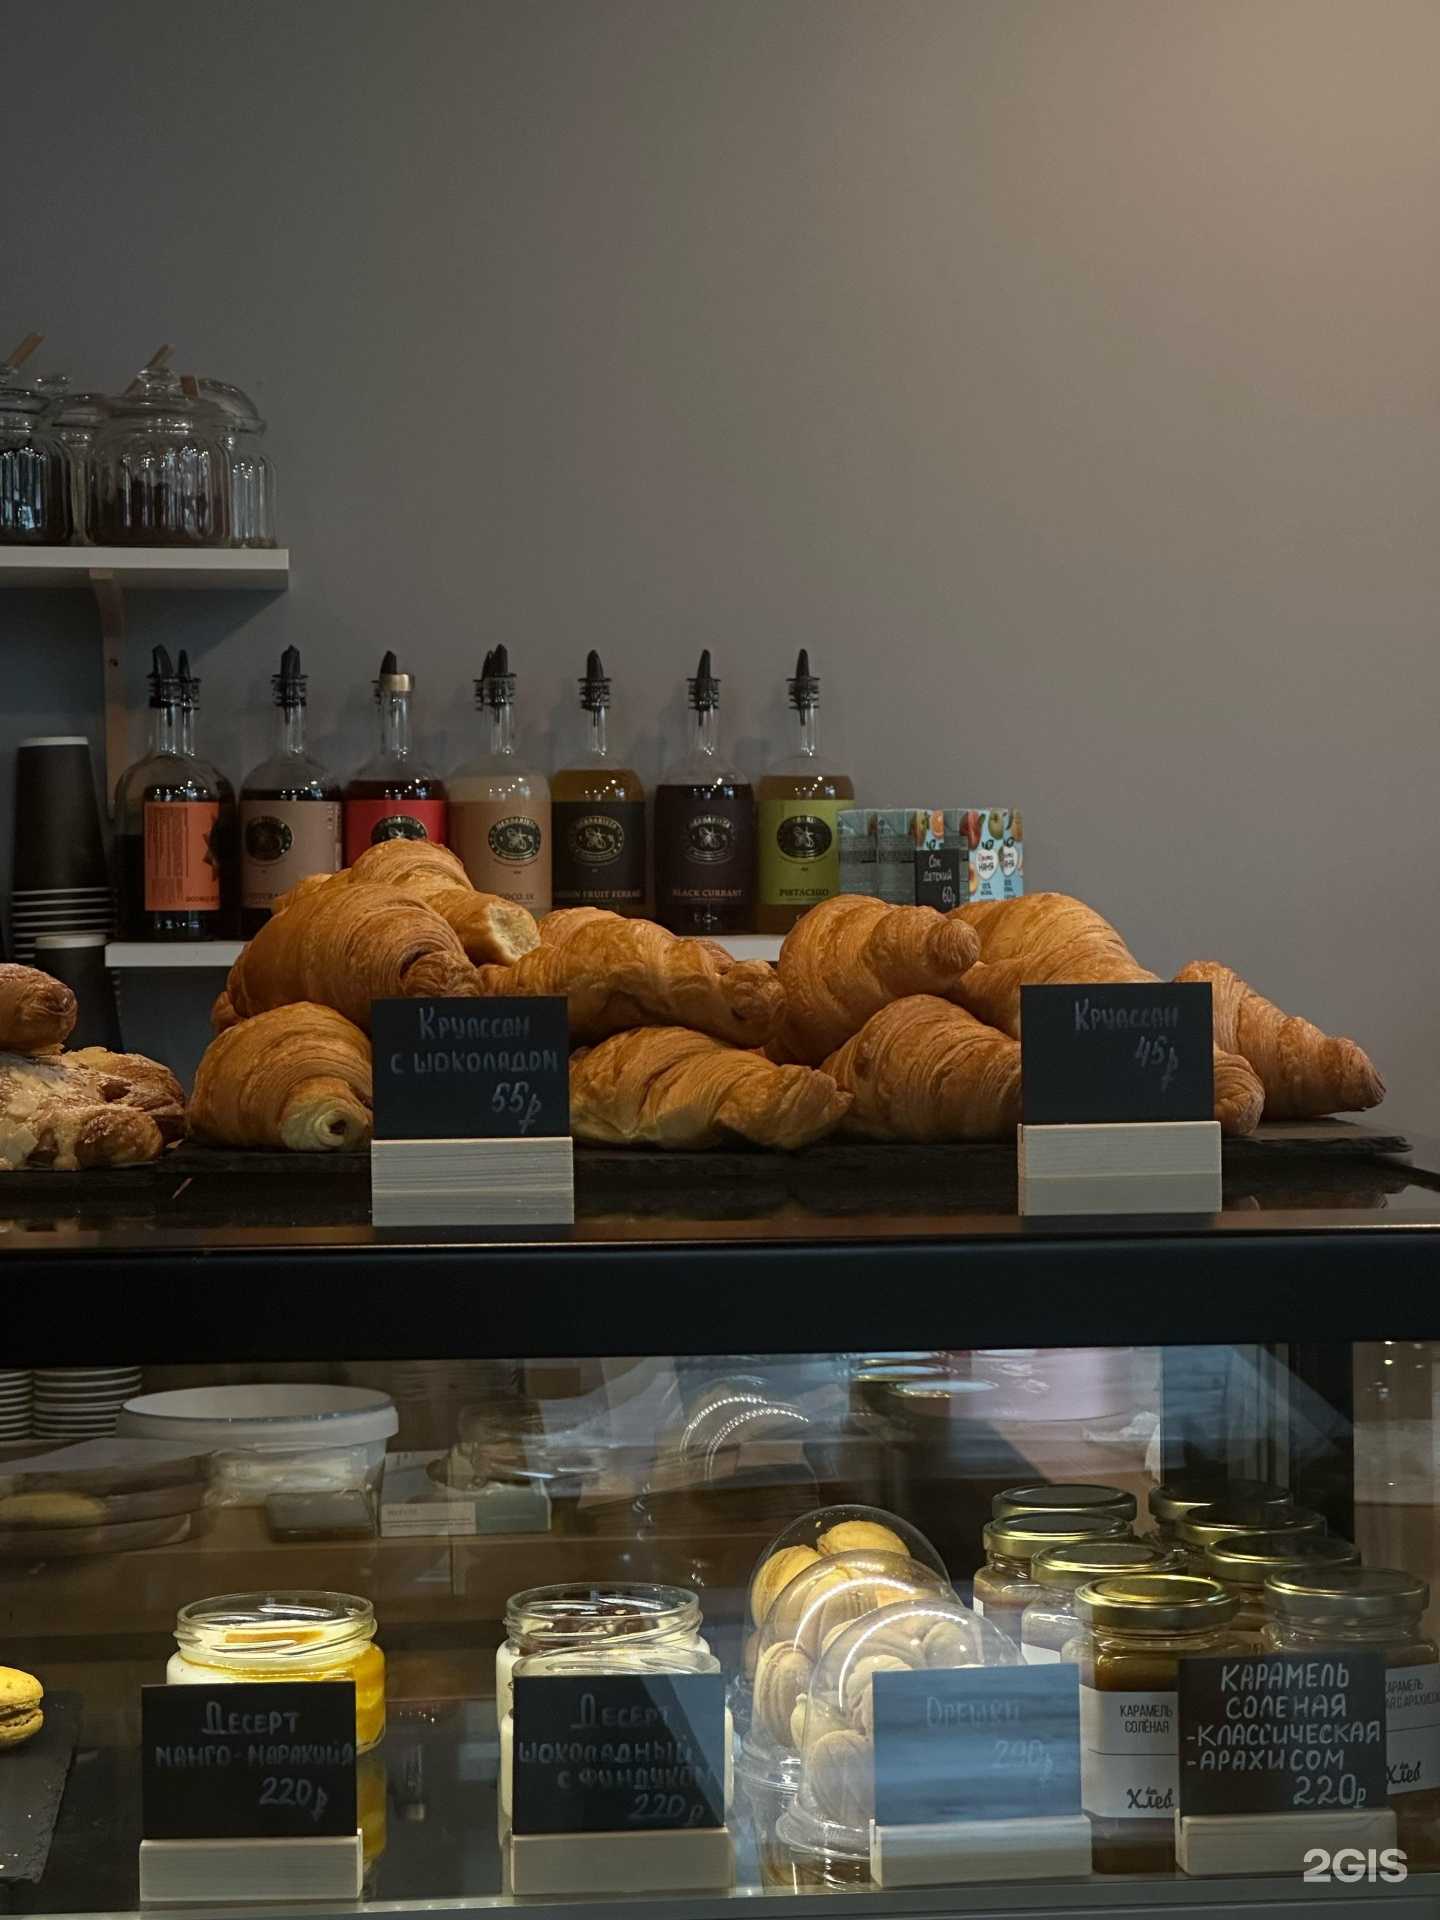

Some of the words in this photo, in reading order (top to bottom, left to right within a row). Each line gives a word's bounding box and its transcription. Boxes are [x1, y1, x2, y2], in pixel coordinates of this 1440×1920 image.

[1221, 1662, 1349, 1692] КАРАМЕЛЬ
[1386, 1679, 1424, 1693] АРАМЕЛЬ
[1120, 1704, 1173, 1718] КАРАМЕЛЬ
[1226, 1694, 1348, 1719] СОЛЕНАЯ
